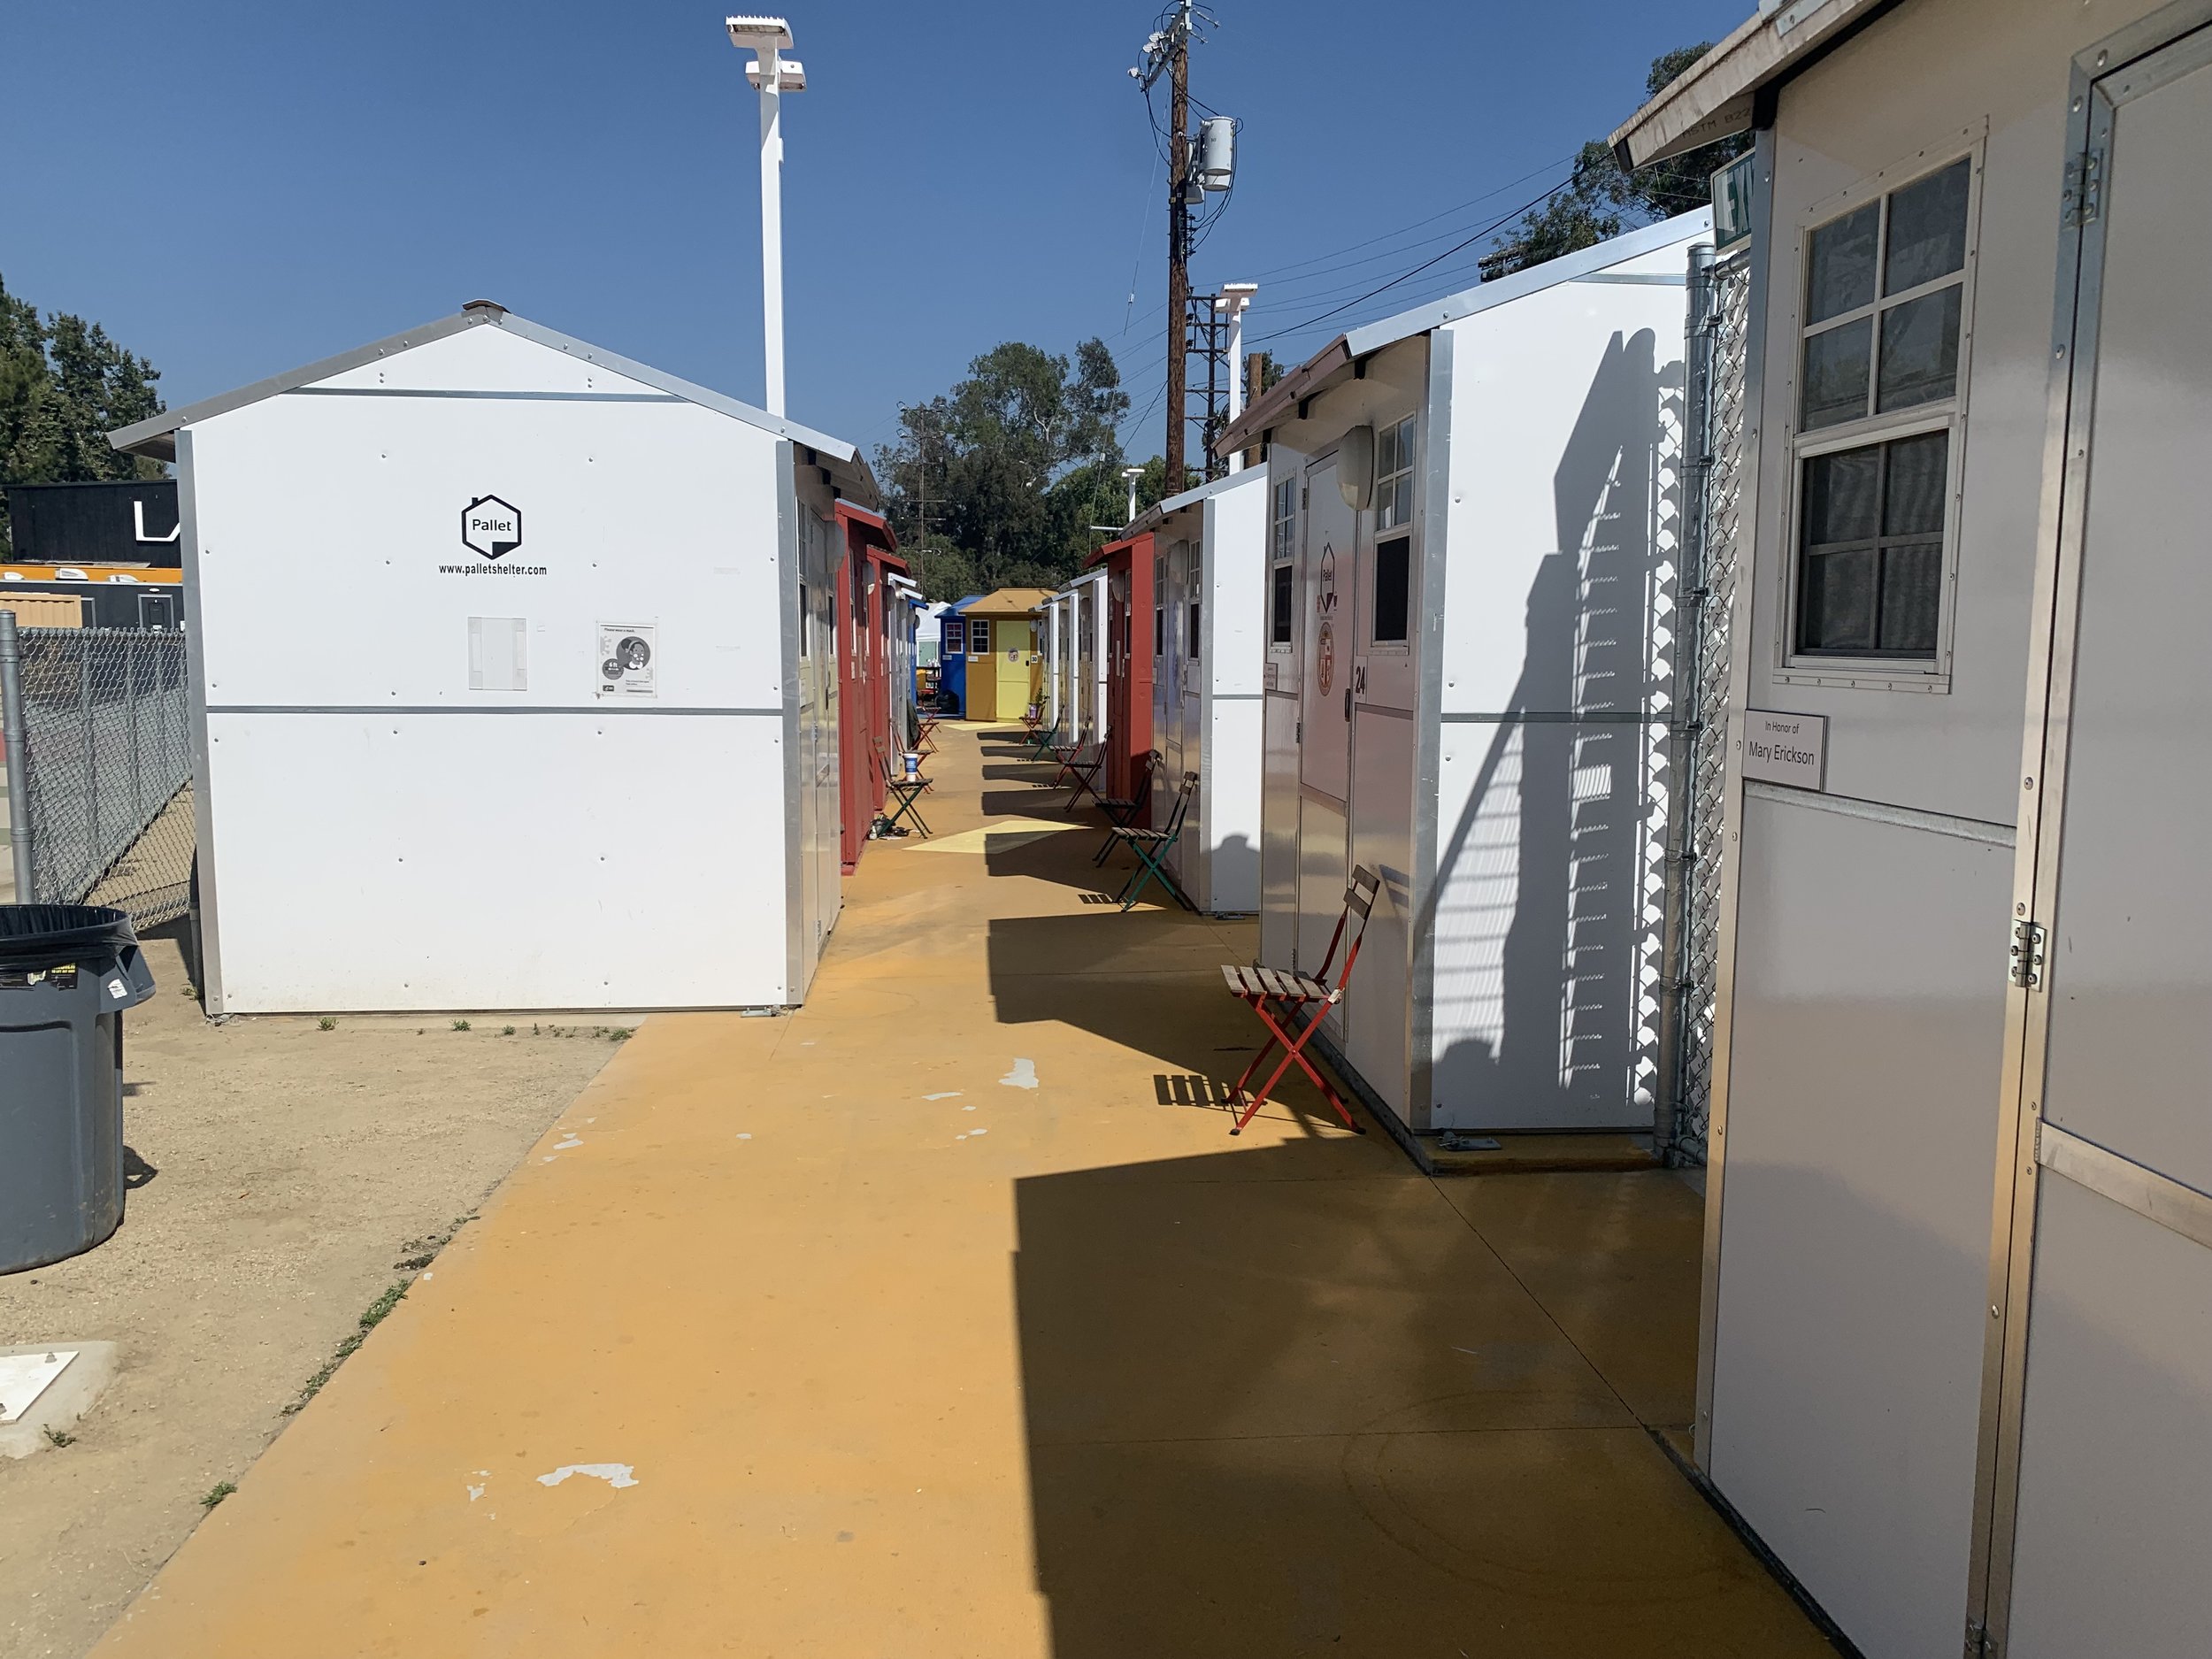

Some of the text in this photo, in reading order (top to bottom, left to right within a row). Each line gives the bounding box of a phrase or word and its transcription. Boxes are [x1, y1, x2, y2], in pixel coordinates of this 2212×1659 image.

[1681, 119, 1717, 138] ASTM
[1722, 157, 1755, 241] EXI
[472, 518, 512, 532] Pallet
[439, 563, 547, 577] www.palletshelter.com
[1356, 665, 1365, 695] 24
[1765, 721, 1800, 734] In Honor of
[1748, 741, 1814, 765] Mary Erickson
